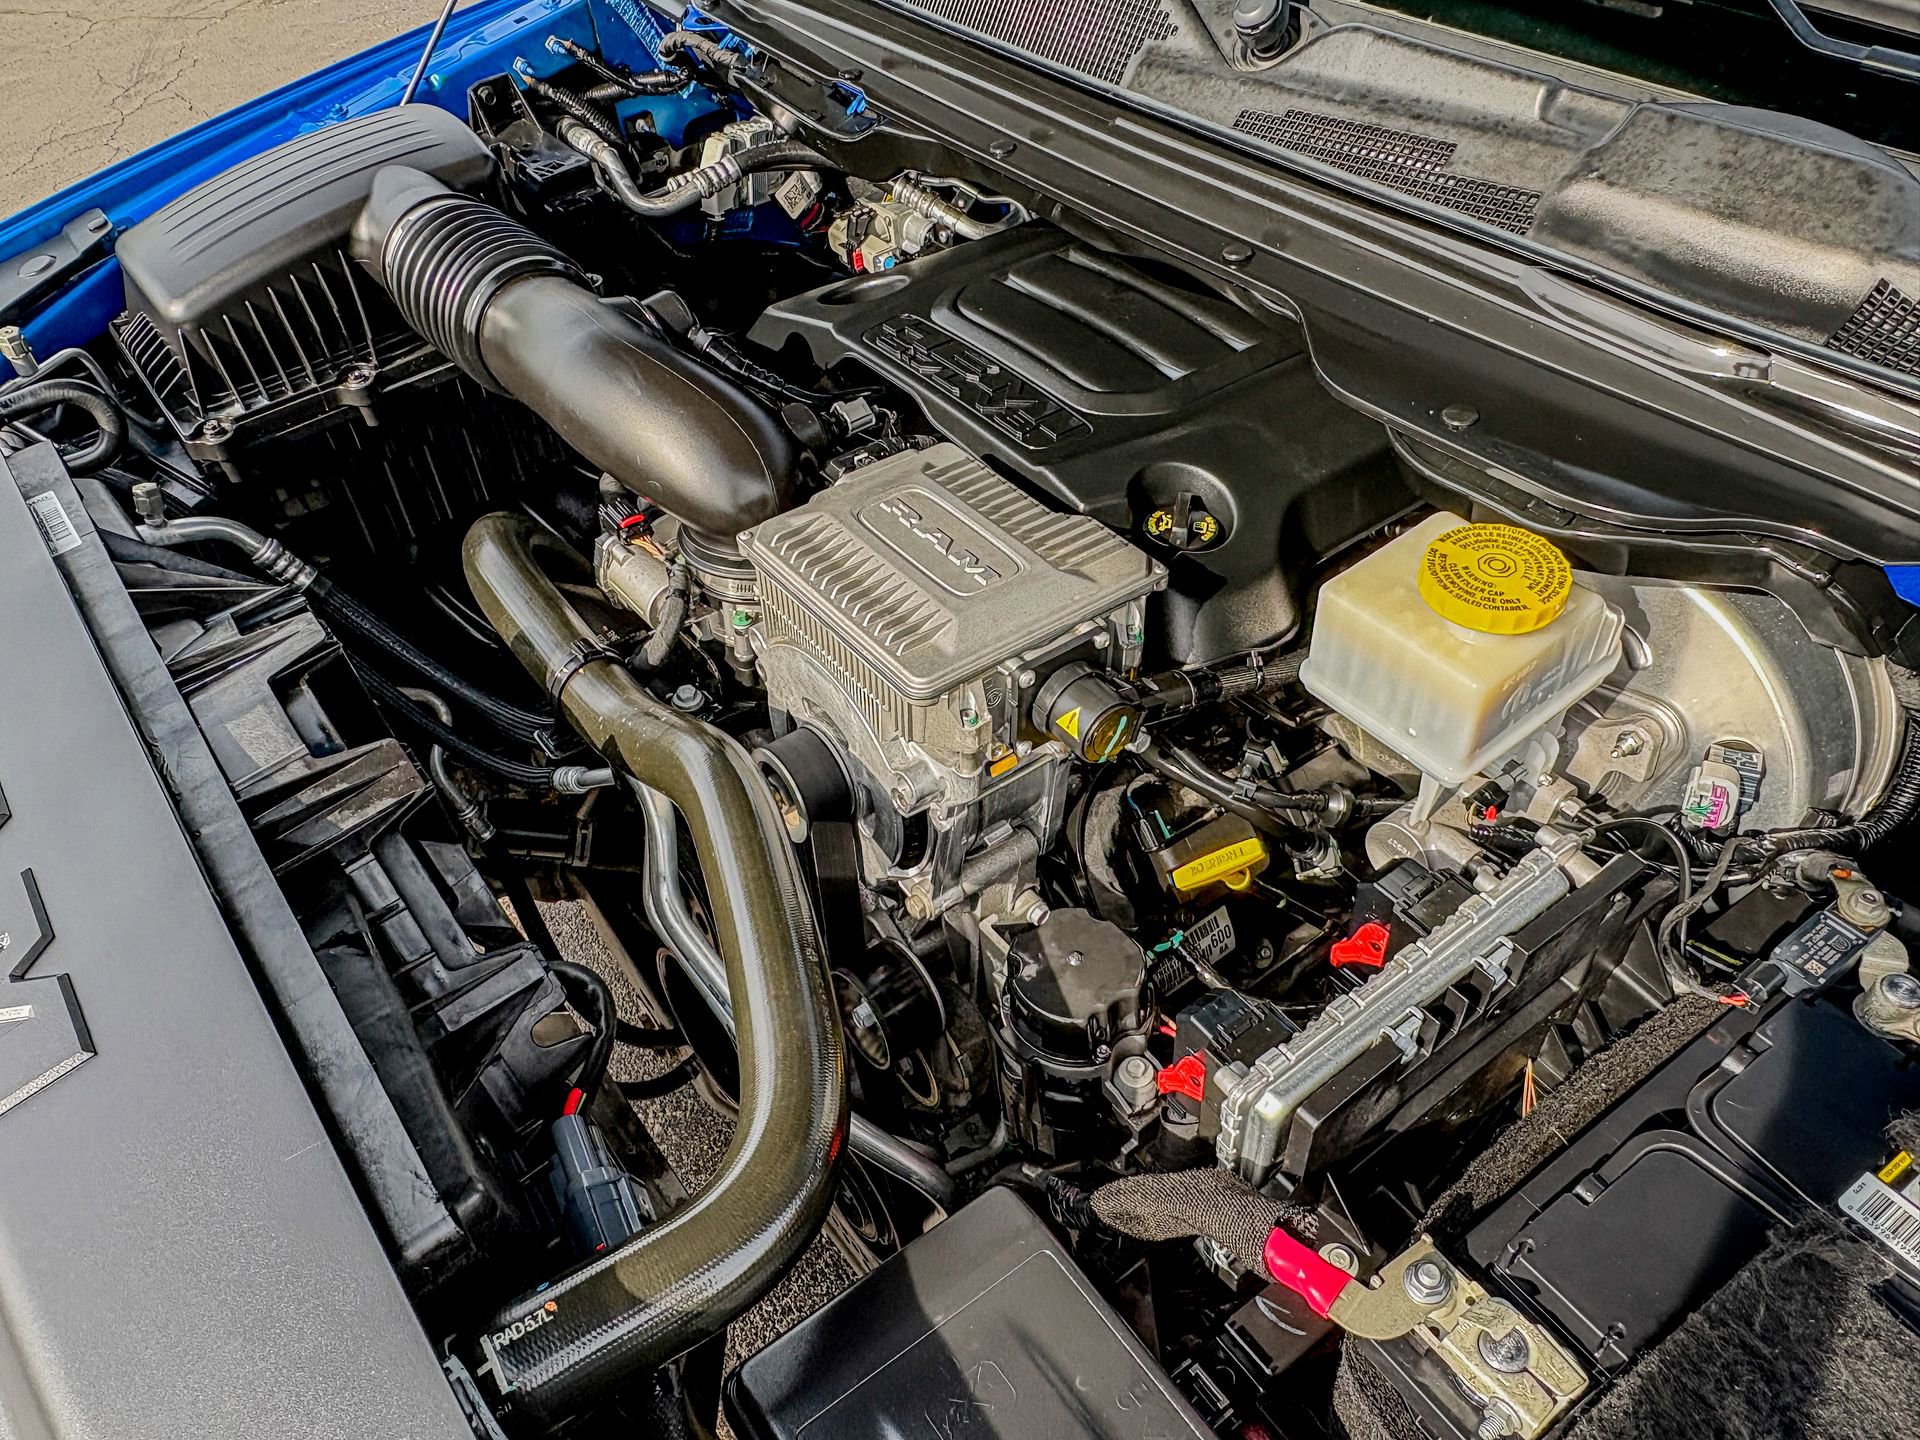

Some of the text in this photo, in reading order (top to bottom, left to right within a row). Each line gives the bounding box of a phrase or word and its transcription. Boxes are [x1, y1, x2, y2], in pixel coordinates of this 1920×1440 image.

[879, 497, 1003, 587] RAM
[1461, 578, 1487, 595] FILLER
[1479, 596, 1497, 604] USE
[1210, 924, 1232, 947] 600
